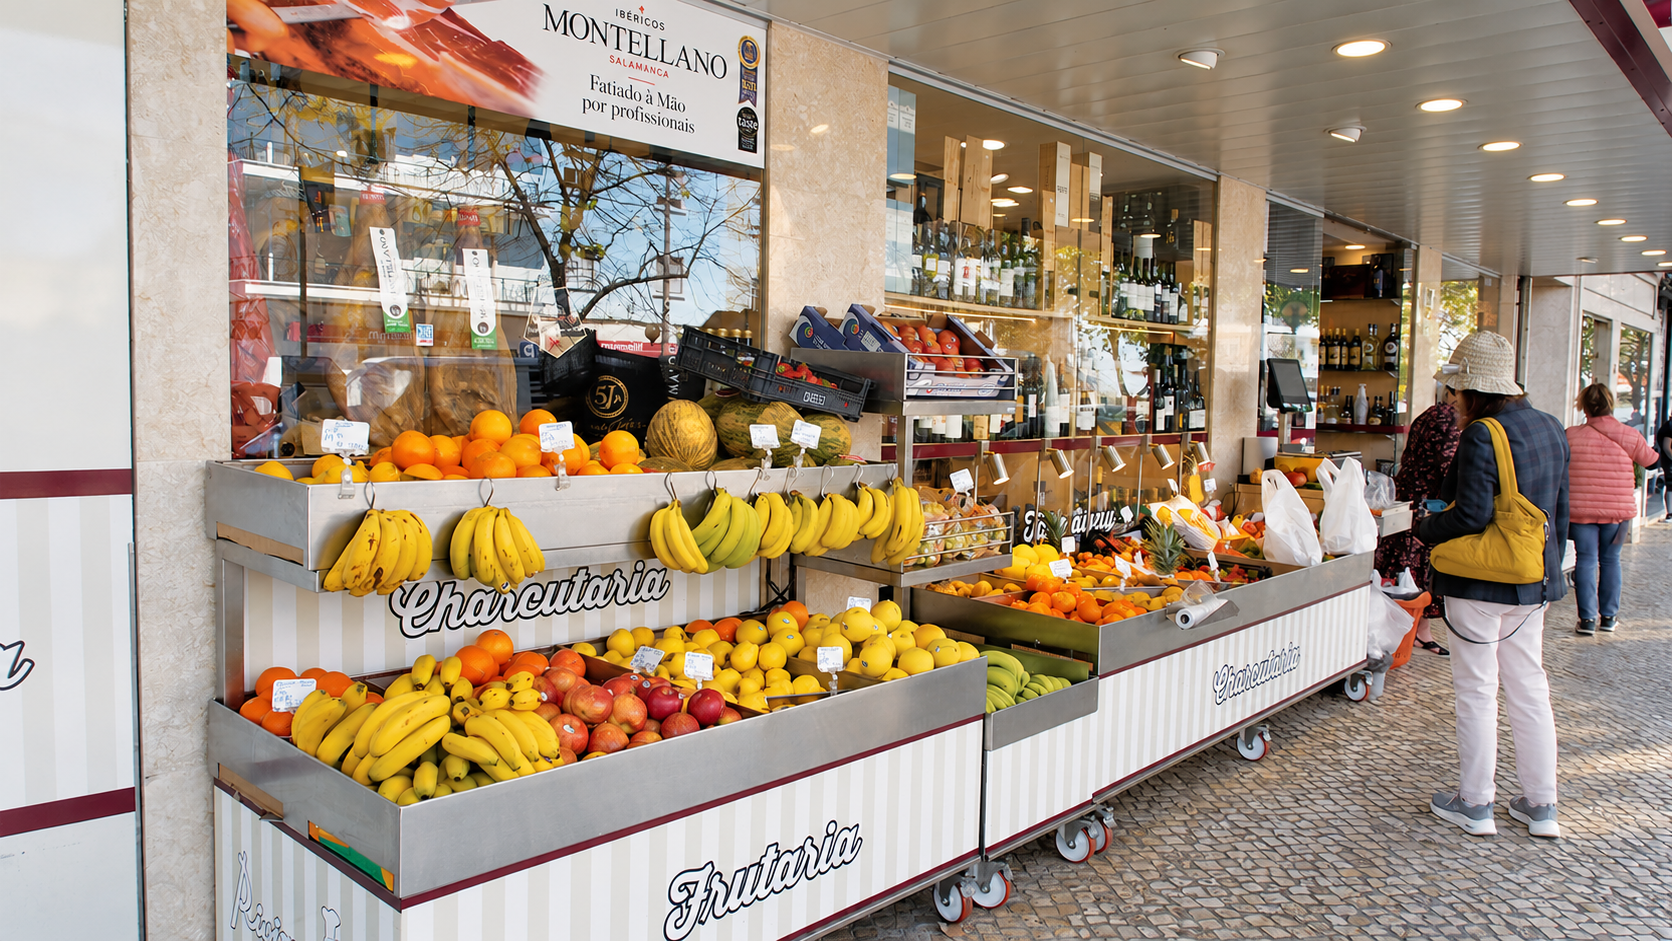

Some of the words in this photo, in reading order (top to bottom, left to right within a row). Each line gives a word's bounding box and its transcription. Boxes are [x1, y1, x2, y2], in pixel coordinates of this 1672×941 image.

[614, 8, 666, 31] IBÉRICOS
[542, 3, 728, 80] MONTELLANO
[609, 54, 670, 79] SALAMANCA
[590, 73, 642, 103] Fatiado
[645, 88, 654, 106] à
[582, 97, 608, 115] por
[611, 104, 696, 134] profissionais
[389, 559, 670, 638] Charcutaria
[663, 819, 864, 941] Frutaria
